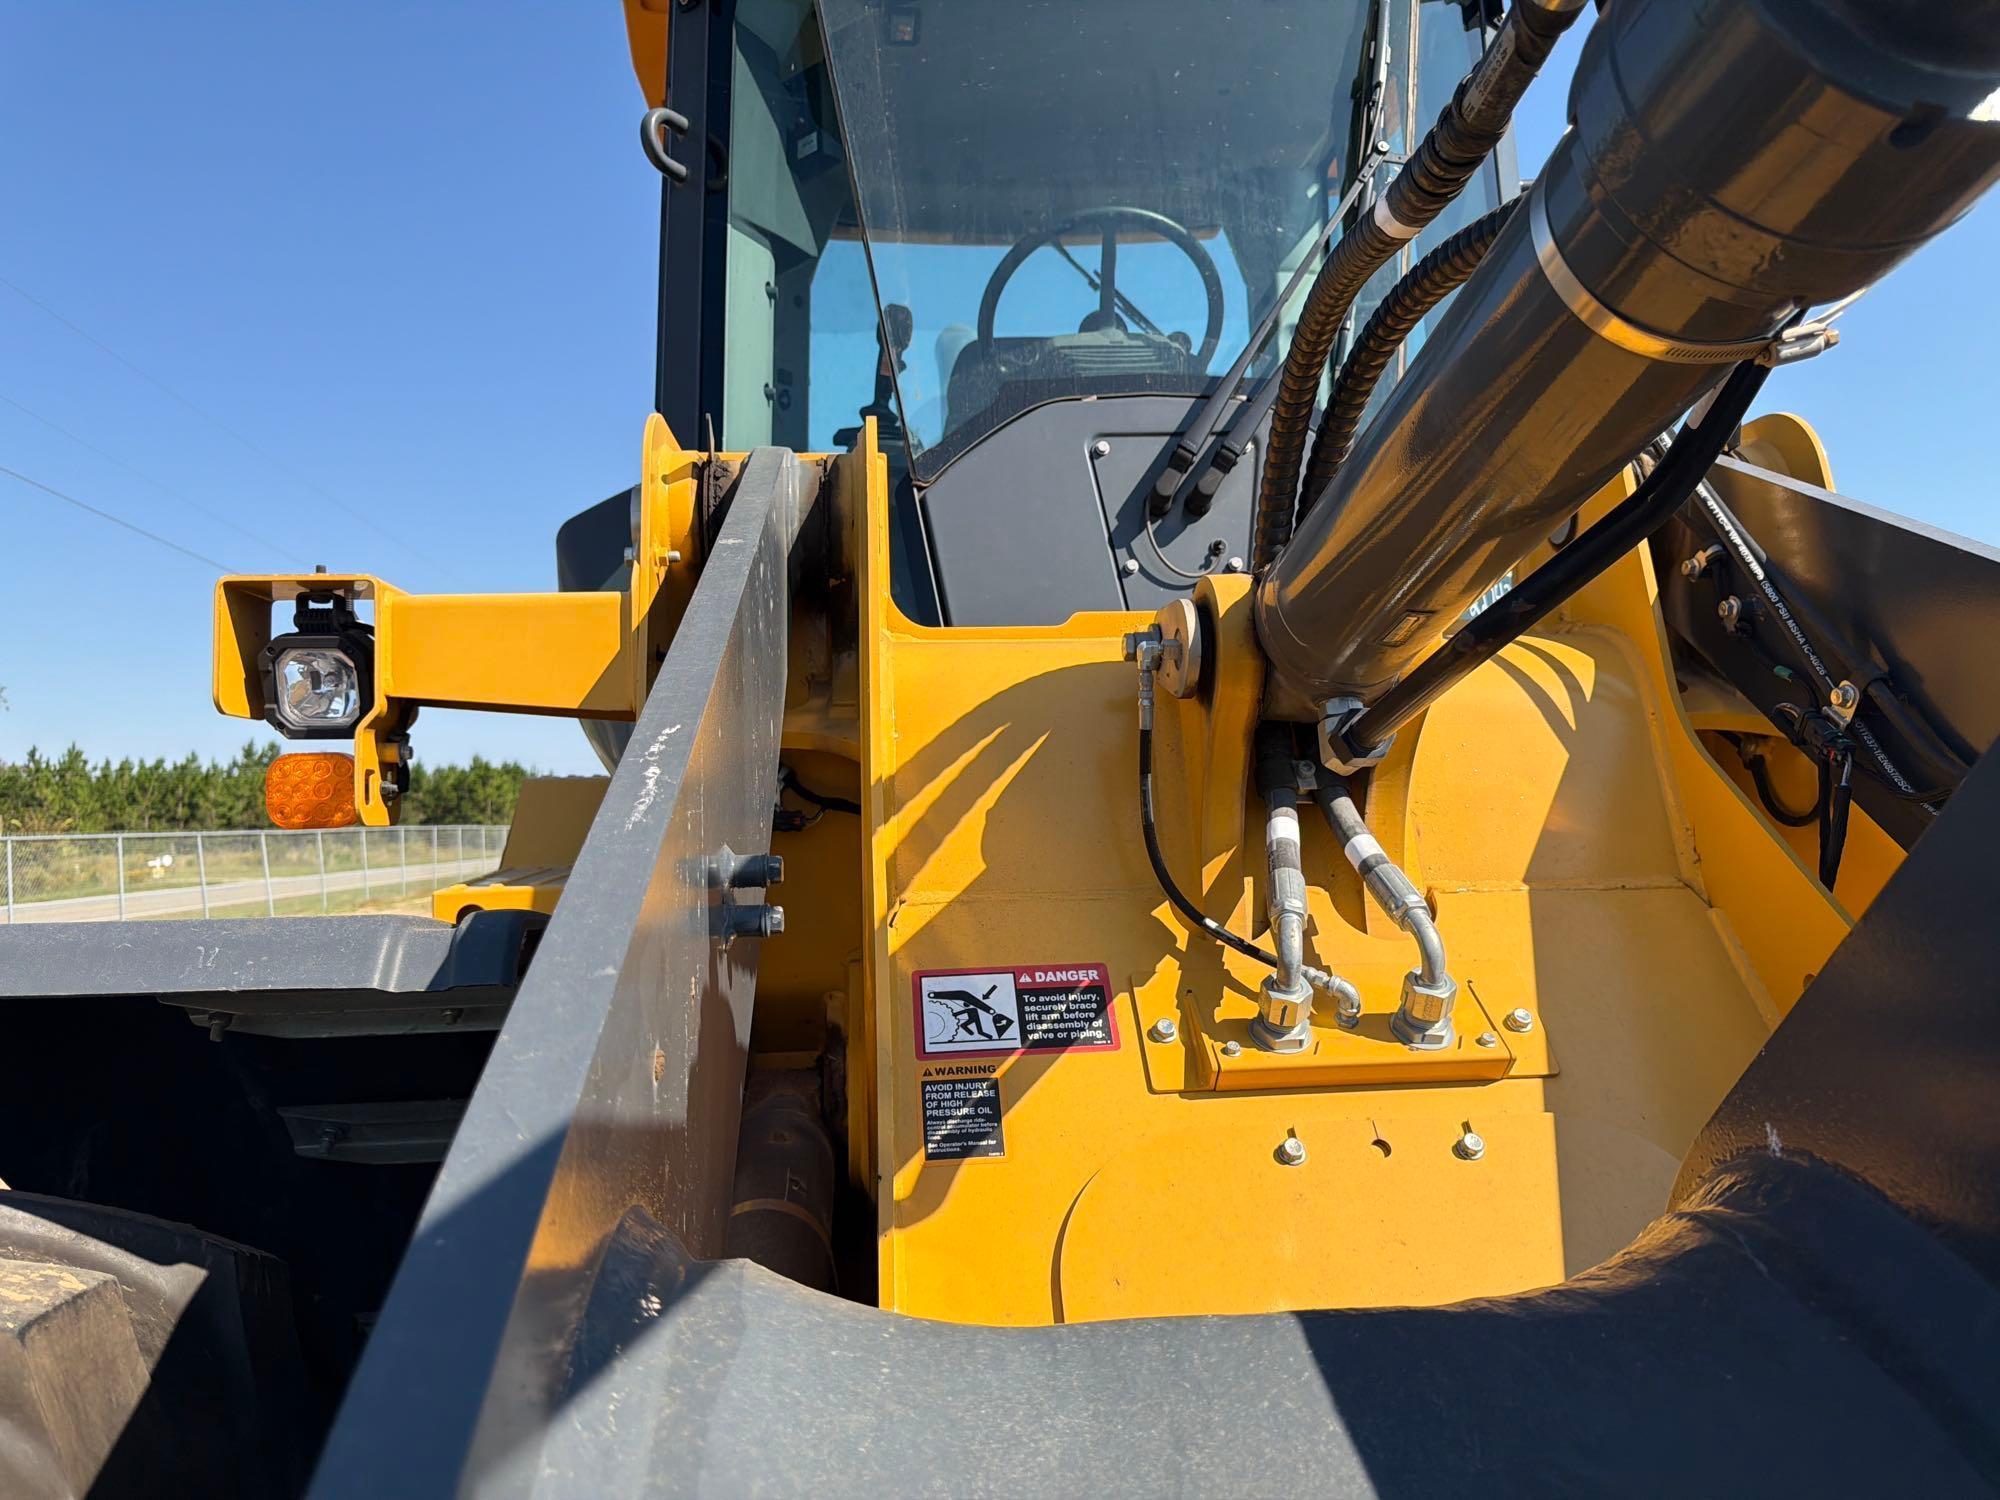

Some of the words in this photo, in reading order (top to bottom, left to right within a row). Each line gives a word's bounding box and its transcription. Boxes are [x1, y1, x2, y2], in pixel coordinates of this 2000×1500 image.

[1775, 602, 1791, 620] PSI)
[1786, 619, 1807, 645] MSHA
[1034, 969, 1100, 983] DANGER
[1023, 995, 1037, 1003] To
[1038, 993, 1066, 1002] avoid
[1024, 1003, 1067, 1012] securely
[1069, 1002, 1098, 1010] brace
[1025, 1013, 1039, 1021] lift
[1063, 1011, 1096, 1019] before
[1026, 1021, 1090, 1031] disassembly
[1092, 1019, 1103, 1027] of
[1027, 1031, 1055, 1040] valve
[1070, 1029, 1106, 1039] piping.
[934, 1065, 997, 1076] WARNING
[925, 1083, 953, 1092] AVOID
[955, 1081, 988, 1090] INJURY
[925, 1092, 952, 1100] FROM
[953, 1090, 996, 1098] RELEASE
[925, 1101, 939, 1109] OF
[940, 1100, 963, 1108] HIGH
[926, 1107, 976, 1117] PRESSURE
